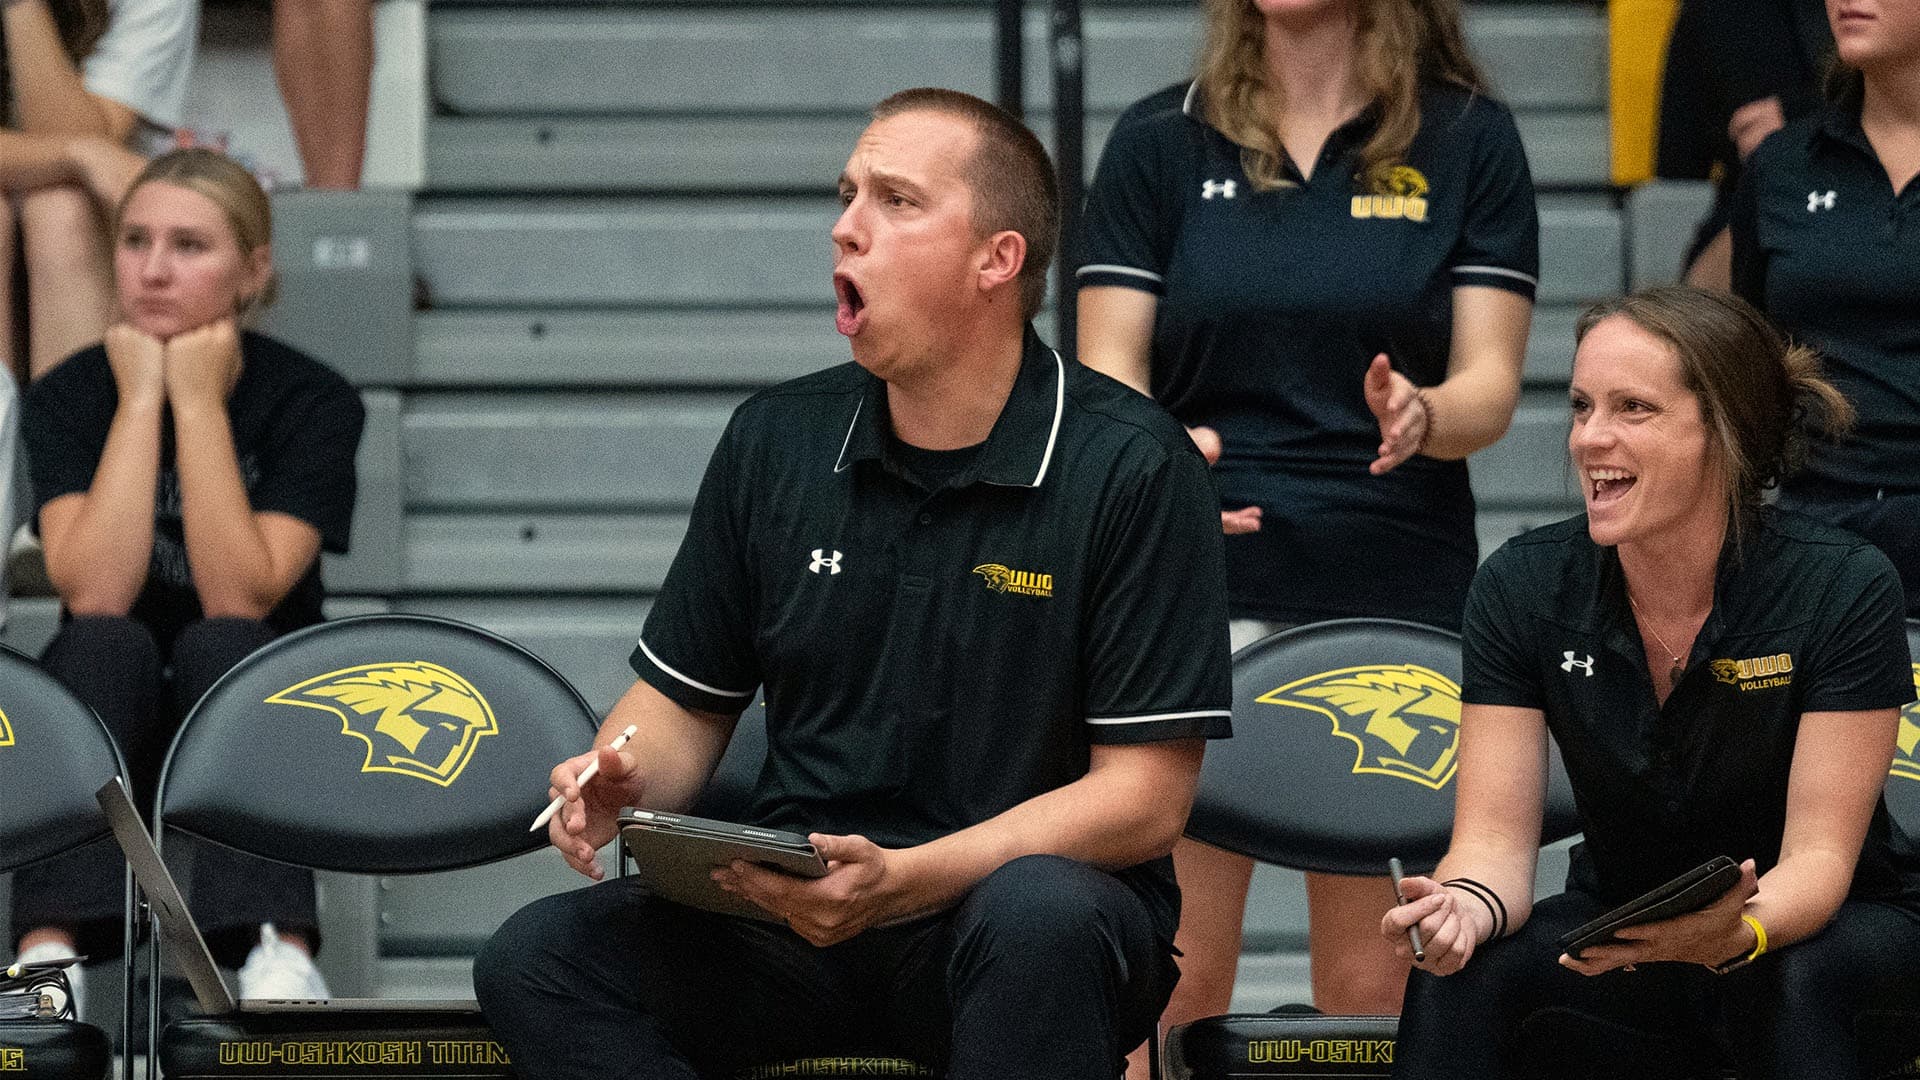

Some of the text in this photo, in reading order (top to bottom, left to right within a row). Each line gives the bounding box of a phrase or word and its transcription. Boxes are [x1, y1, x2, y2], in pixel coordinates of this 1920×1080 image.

[1351, 195, 1427, 222] UWO
[1007, 585, 1053, 597] VOLLEYBALL
[1008, 570, 1053, 590] UWO
[1737, 653, 1793, 679] UWO
[219, 1041, 511, 1065] UW-OSHKOSH TITAN
[1249, 1040, 1396, 1063] UW-OSHK
